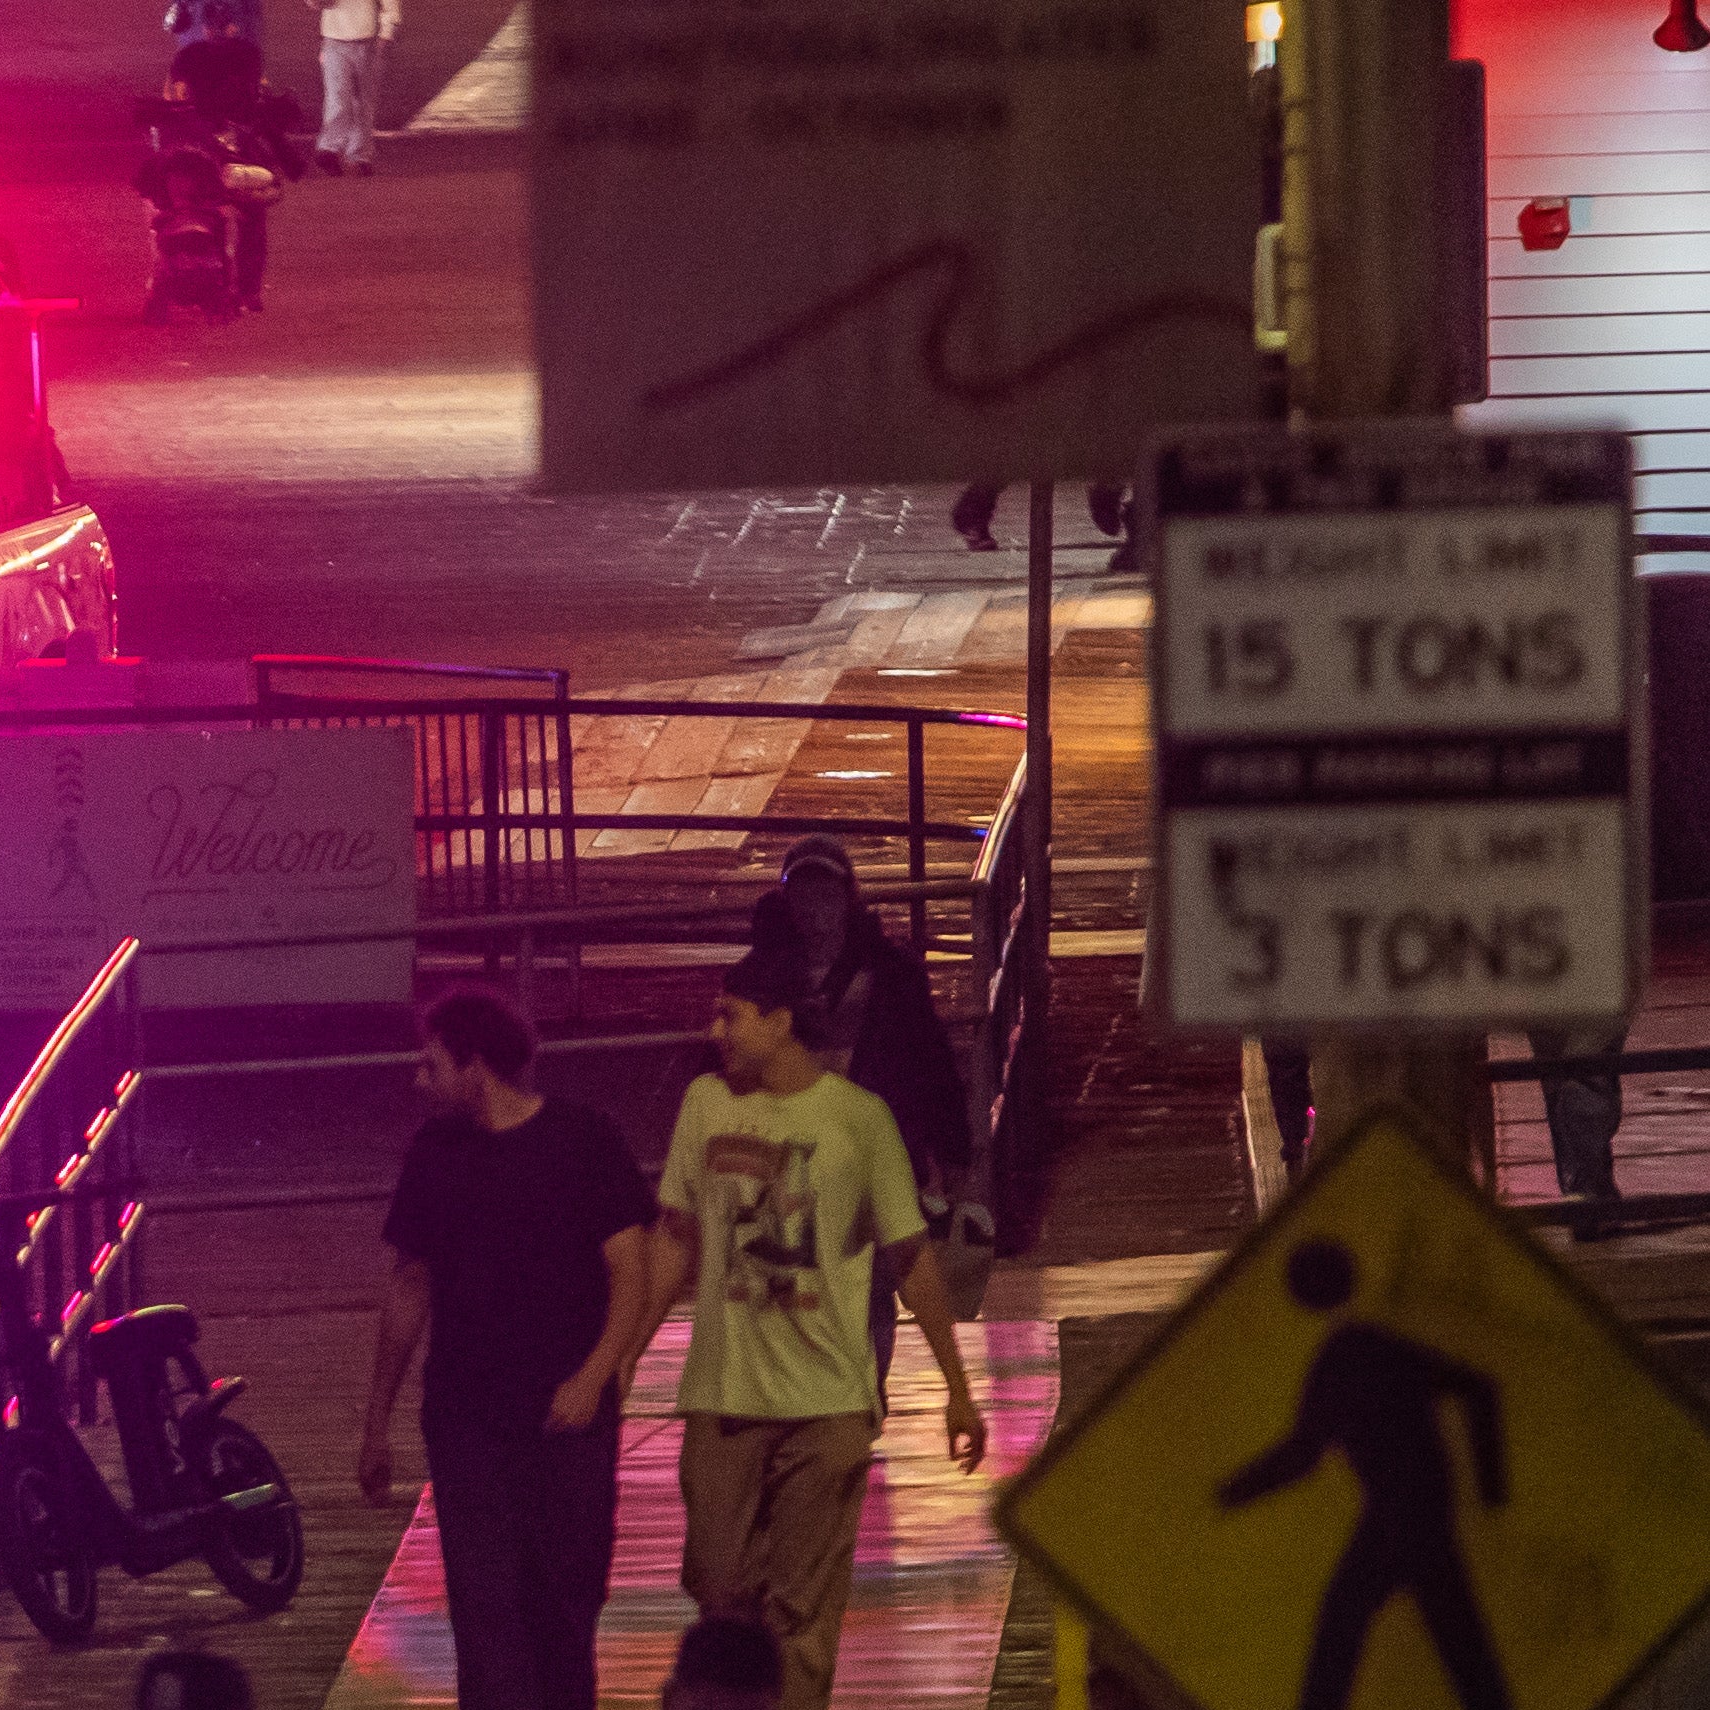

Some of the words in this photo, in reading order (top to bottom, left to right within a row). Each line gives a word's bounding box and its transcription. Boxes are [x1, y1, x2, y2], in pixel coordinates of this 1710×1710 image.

[1202, 613, 1298, 697] 15
[1339, 607, 1586, 697] TONS
[146, 770, 396, 882] Welcome
[1328, 906, 1571, 993] TONS
